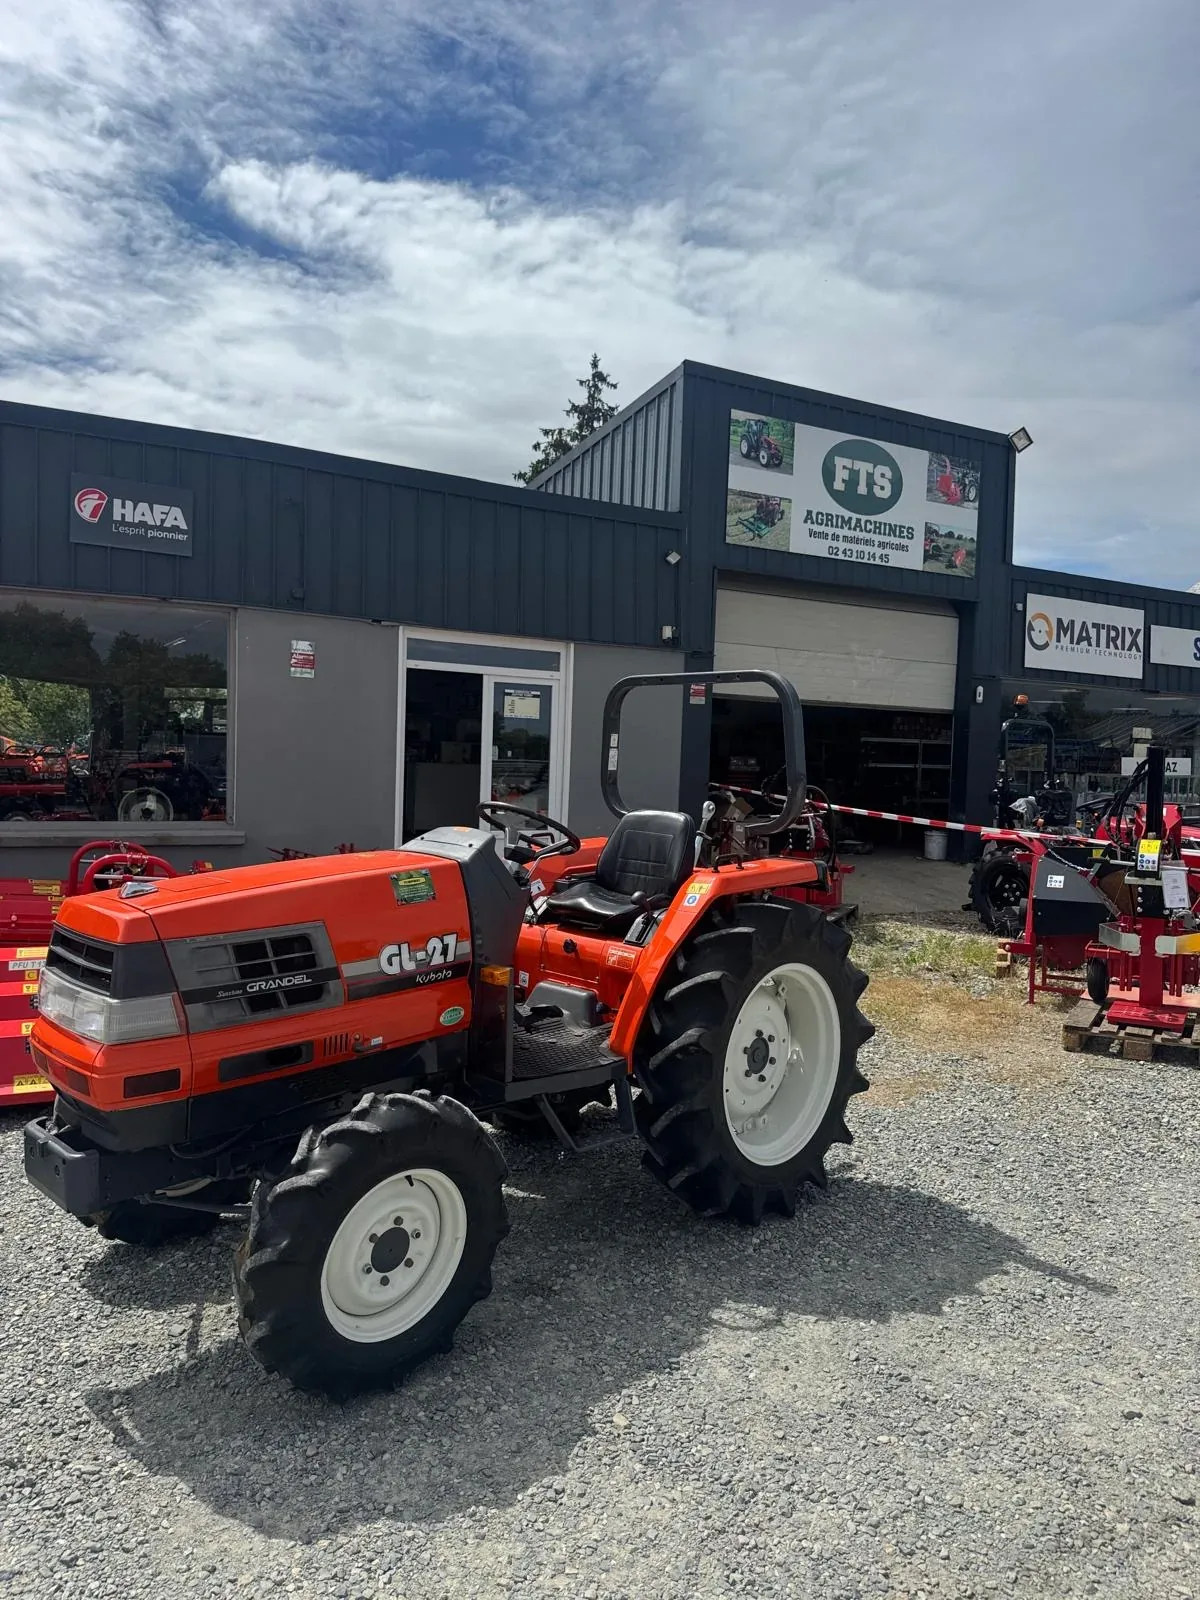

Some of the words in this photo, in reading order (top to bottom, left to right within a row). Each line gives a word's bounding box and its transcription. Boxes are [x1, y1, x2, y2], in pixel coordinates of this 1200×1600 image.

[833, 456, 892, 499] FTS
[113, 498, 188, 530] HAFA
[112, 523, 145, 536] L'esprit
[147, 528, 188, 541] pionnier
[803, 509, 914, 541] AGRIMACHINES
[808, 528, 829, 540] Vente
[831, 532, 840, 542] de
[877, 540, 909, 552] agricoles
[828, 545, 839, 557] 02
[842, 548, 853, 558] 43
[856, 549, 865, 560] 10
[867, 551, 876, 561] 14
[879, 553, 890, 564] 45
[1056, 617, 1142, 652] MATRIX
[1055, 645, 1090, 655] PREMIUM
[1094, 649, 1142, 661] TECHNOLOGY
[379, 933, 457, 975] GL-27
[12, 961, 28, 969] PFU
[246, 974, 312, 992] GRANDEL
[415, 969, 452, 984] Kubota
